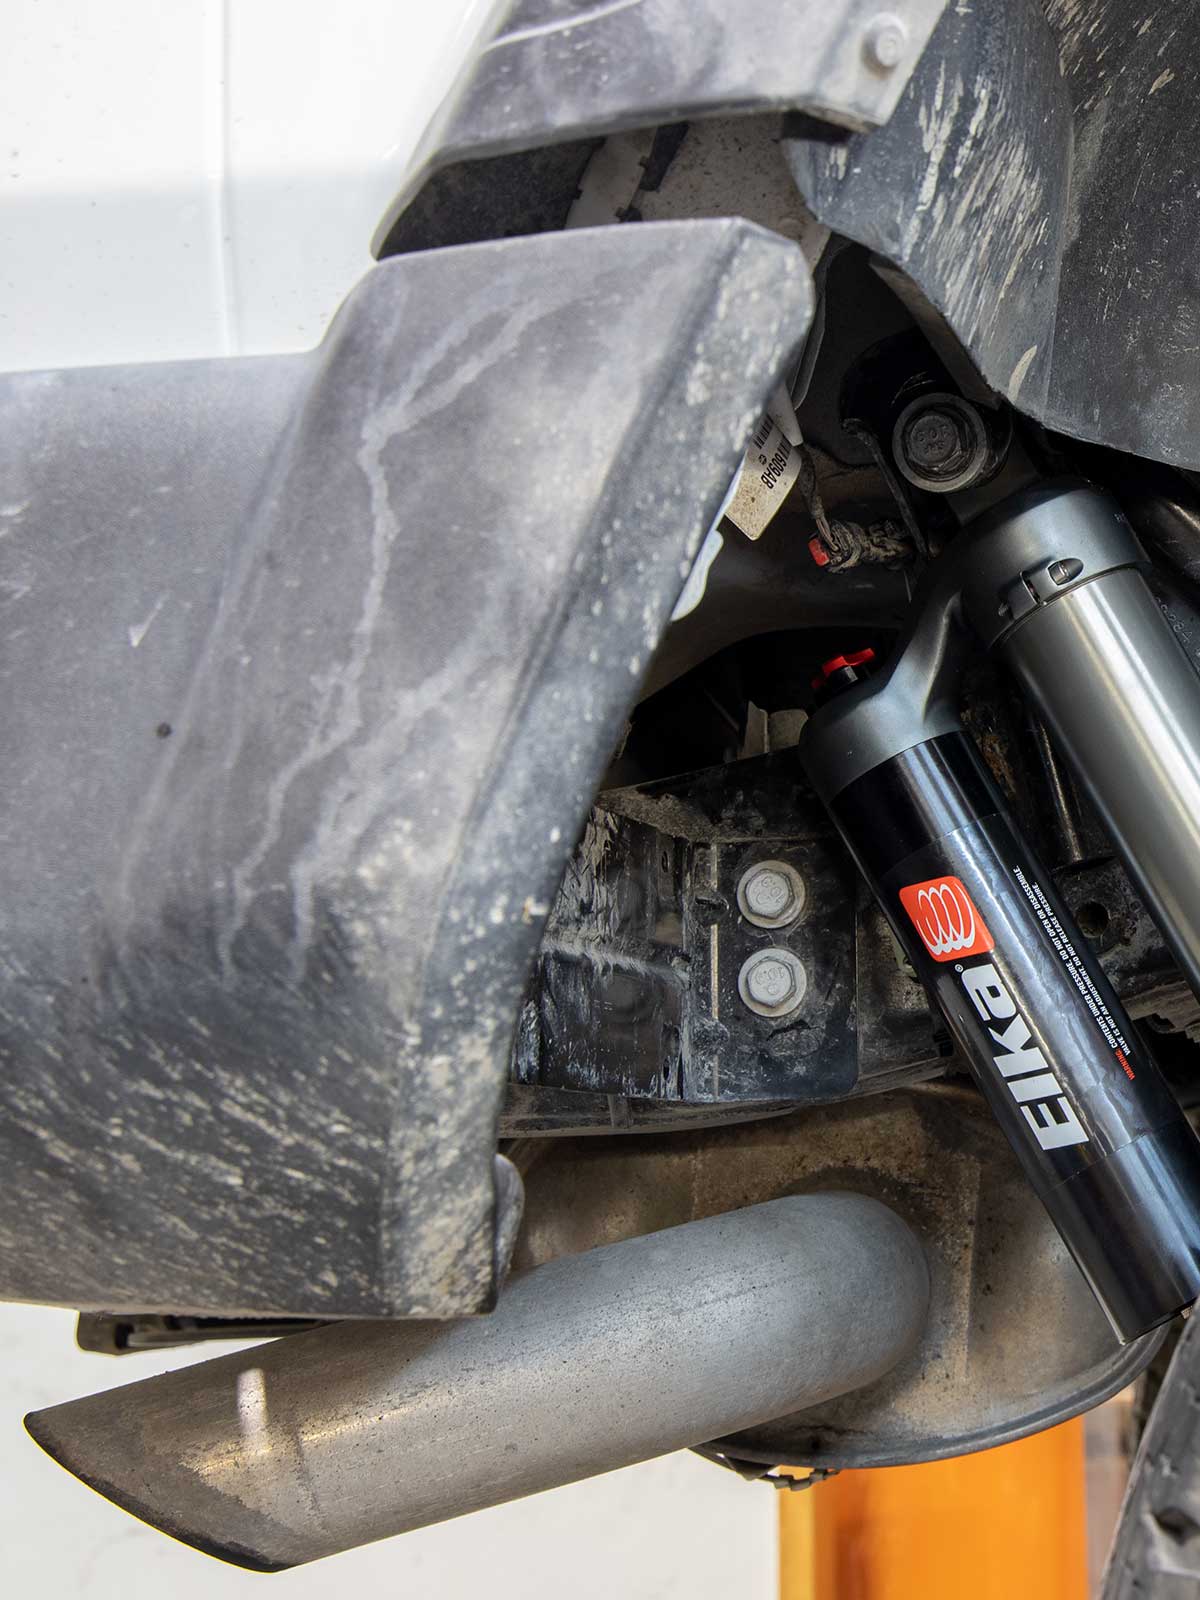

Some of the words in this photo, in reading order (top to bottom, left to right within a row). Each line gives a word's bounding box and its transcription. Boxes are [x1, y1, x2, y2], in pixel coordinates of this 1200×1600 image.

[761, 455, 787, 489] 609AB
[1035, 908, 1046, 920] OR
[1041, 918, 1056, 937] OPEN
[1049, 915, 1068, 943] RELEASE
[1051, 935, 1063, 951] NOT
[1065, 942, 1076, 956] NOT
[1058, 948, 1069, 960] DO
[1072, 955, 1081, 966] DO
[1083, 993, 1100, 1017] UNDER
[1099, 1005, 1109, 1016] AN
[1105, 1014, 1116, 1029] NOT
[1095, 1014, 1118, 1049] CONTENTS
[1112, 1027, 1120, 1036] IS
[1116, 1035, 1131, 1055] VALVE
[961, 963, 1090, 1151] Elka
